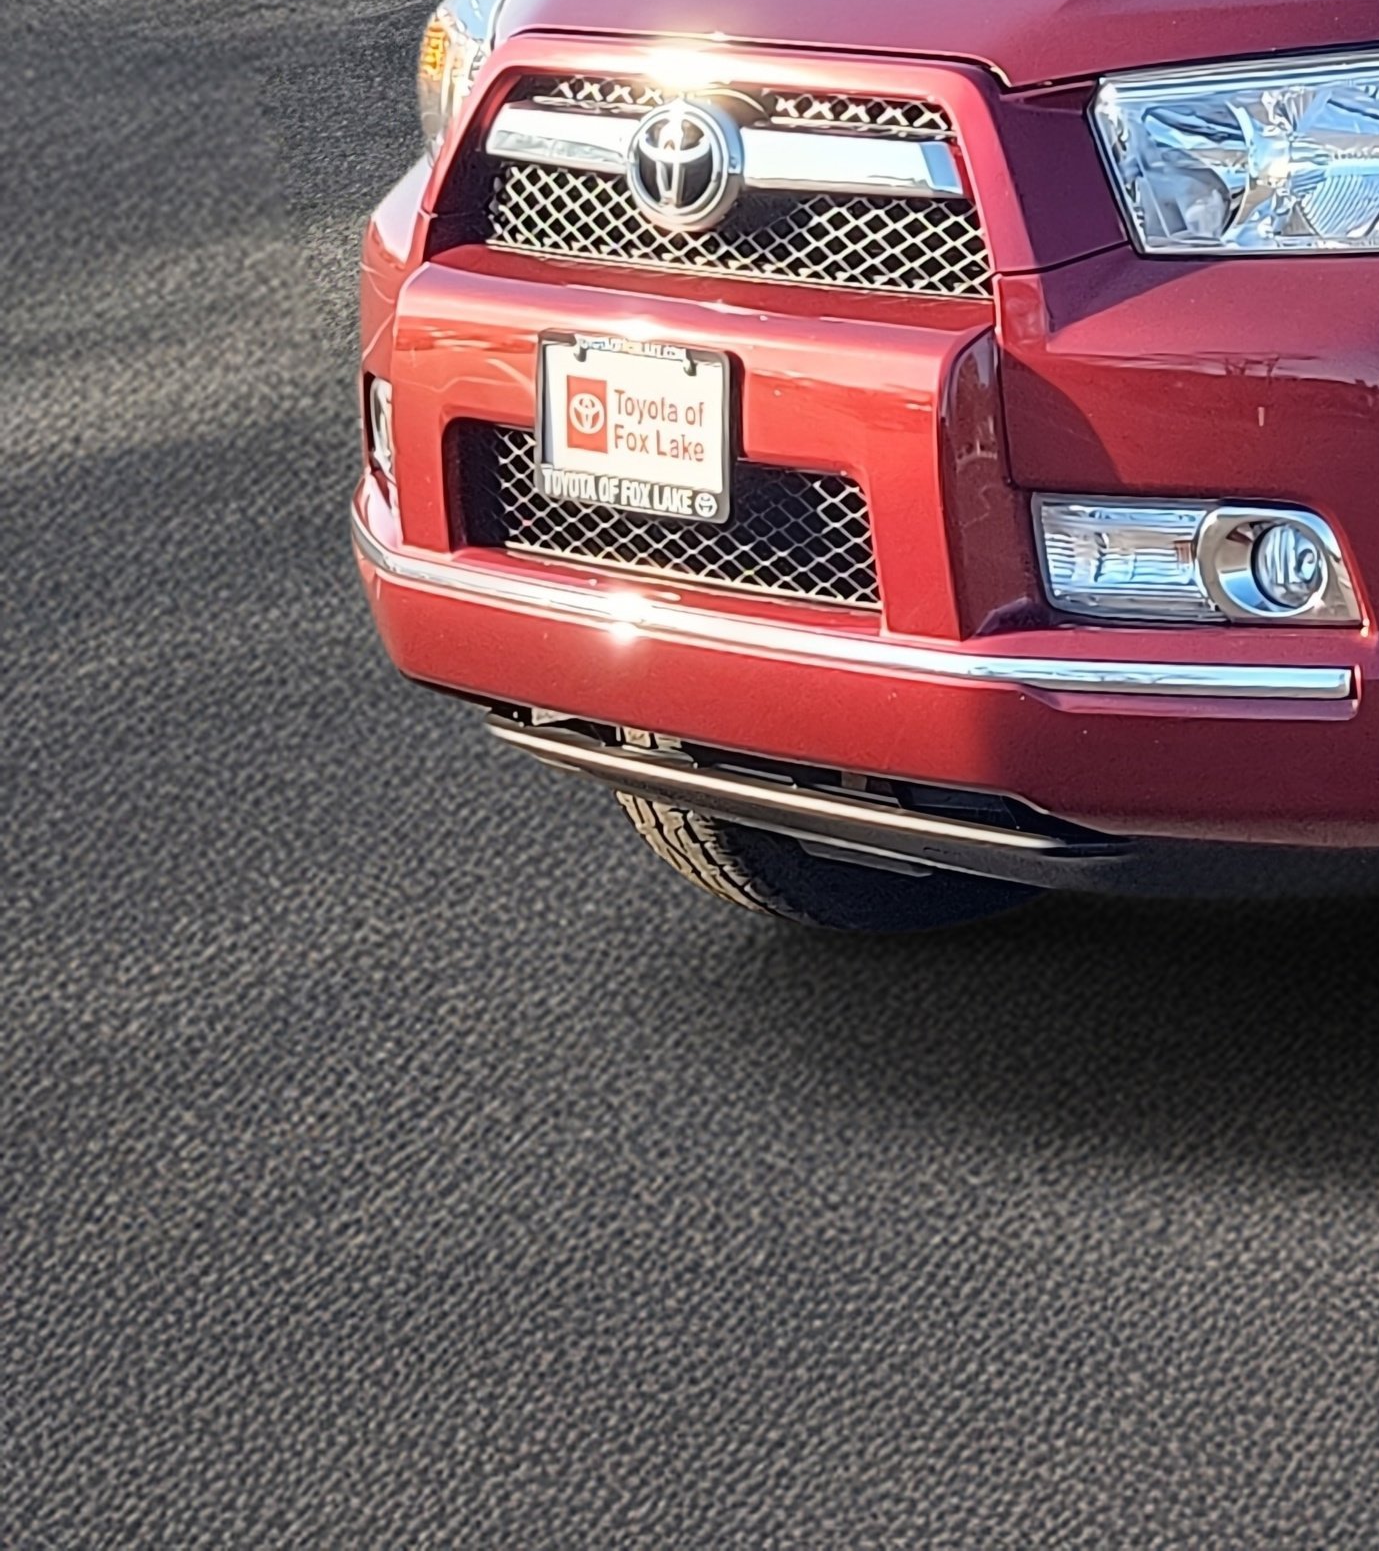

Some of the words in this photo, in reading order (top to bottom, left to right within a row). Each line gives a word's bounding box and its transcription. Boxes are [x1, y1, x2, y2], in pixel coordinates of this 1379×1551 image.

[613, 388, 679, 425] Toyota
[685, 401, 705, 427] of
[613, 423, 650, 455] Fox
[656, 429, 705, 463] Lake
[542, 469, 598, 500] TOYOTA
[599, 476, 619, 504] OF
[621, 480, 651, 509] FOX
[653, 485, 693, 515] LAKE
